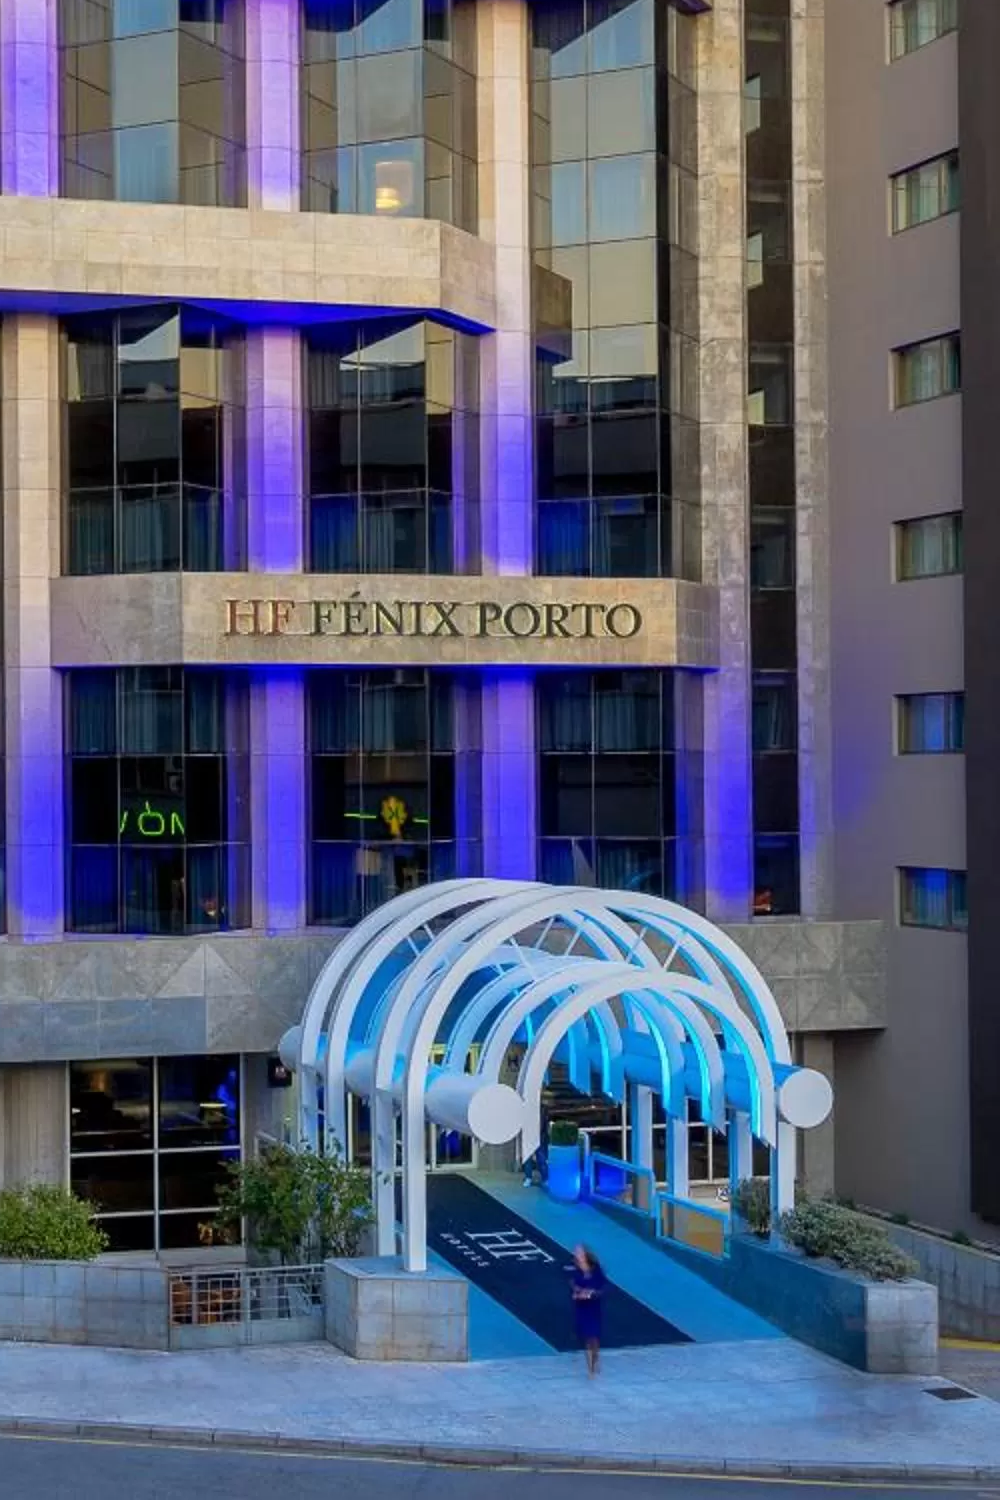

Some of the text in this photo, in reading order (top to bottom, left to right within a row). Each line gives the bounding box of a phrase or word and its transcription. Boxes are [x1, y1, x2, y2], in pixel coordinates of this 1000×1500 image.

[224, 590, 643, 639] HF FÉNIX PORTO
[464, 1228, 555, 1263] HF
